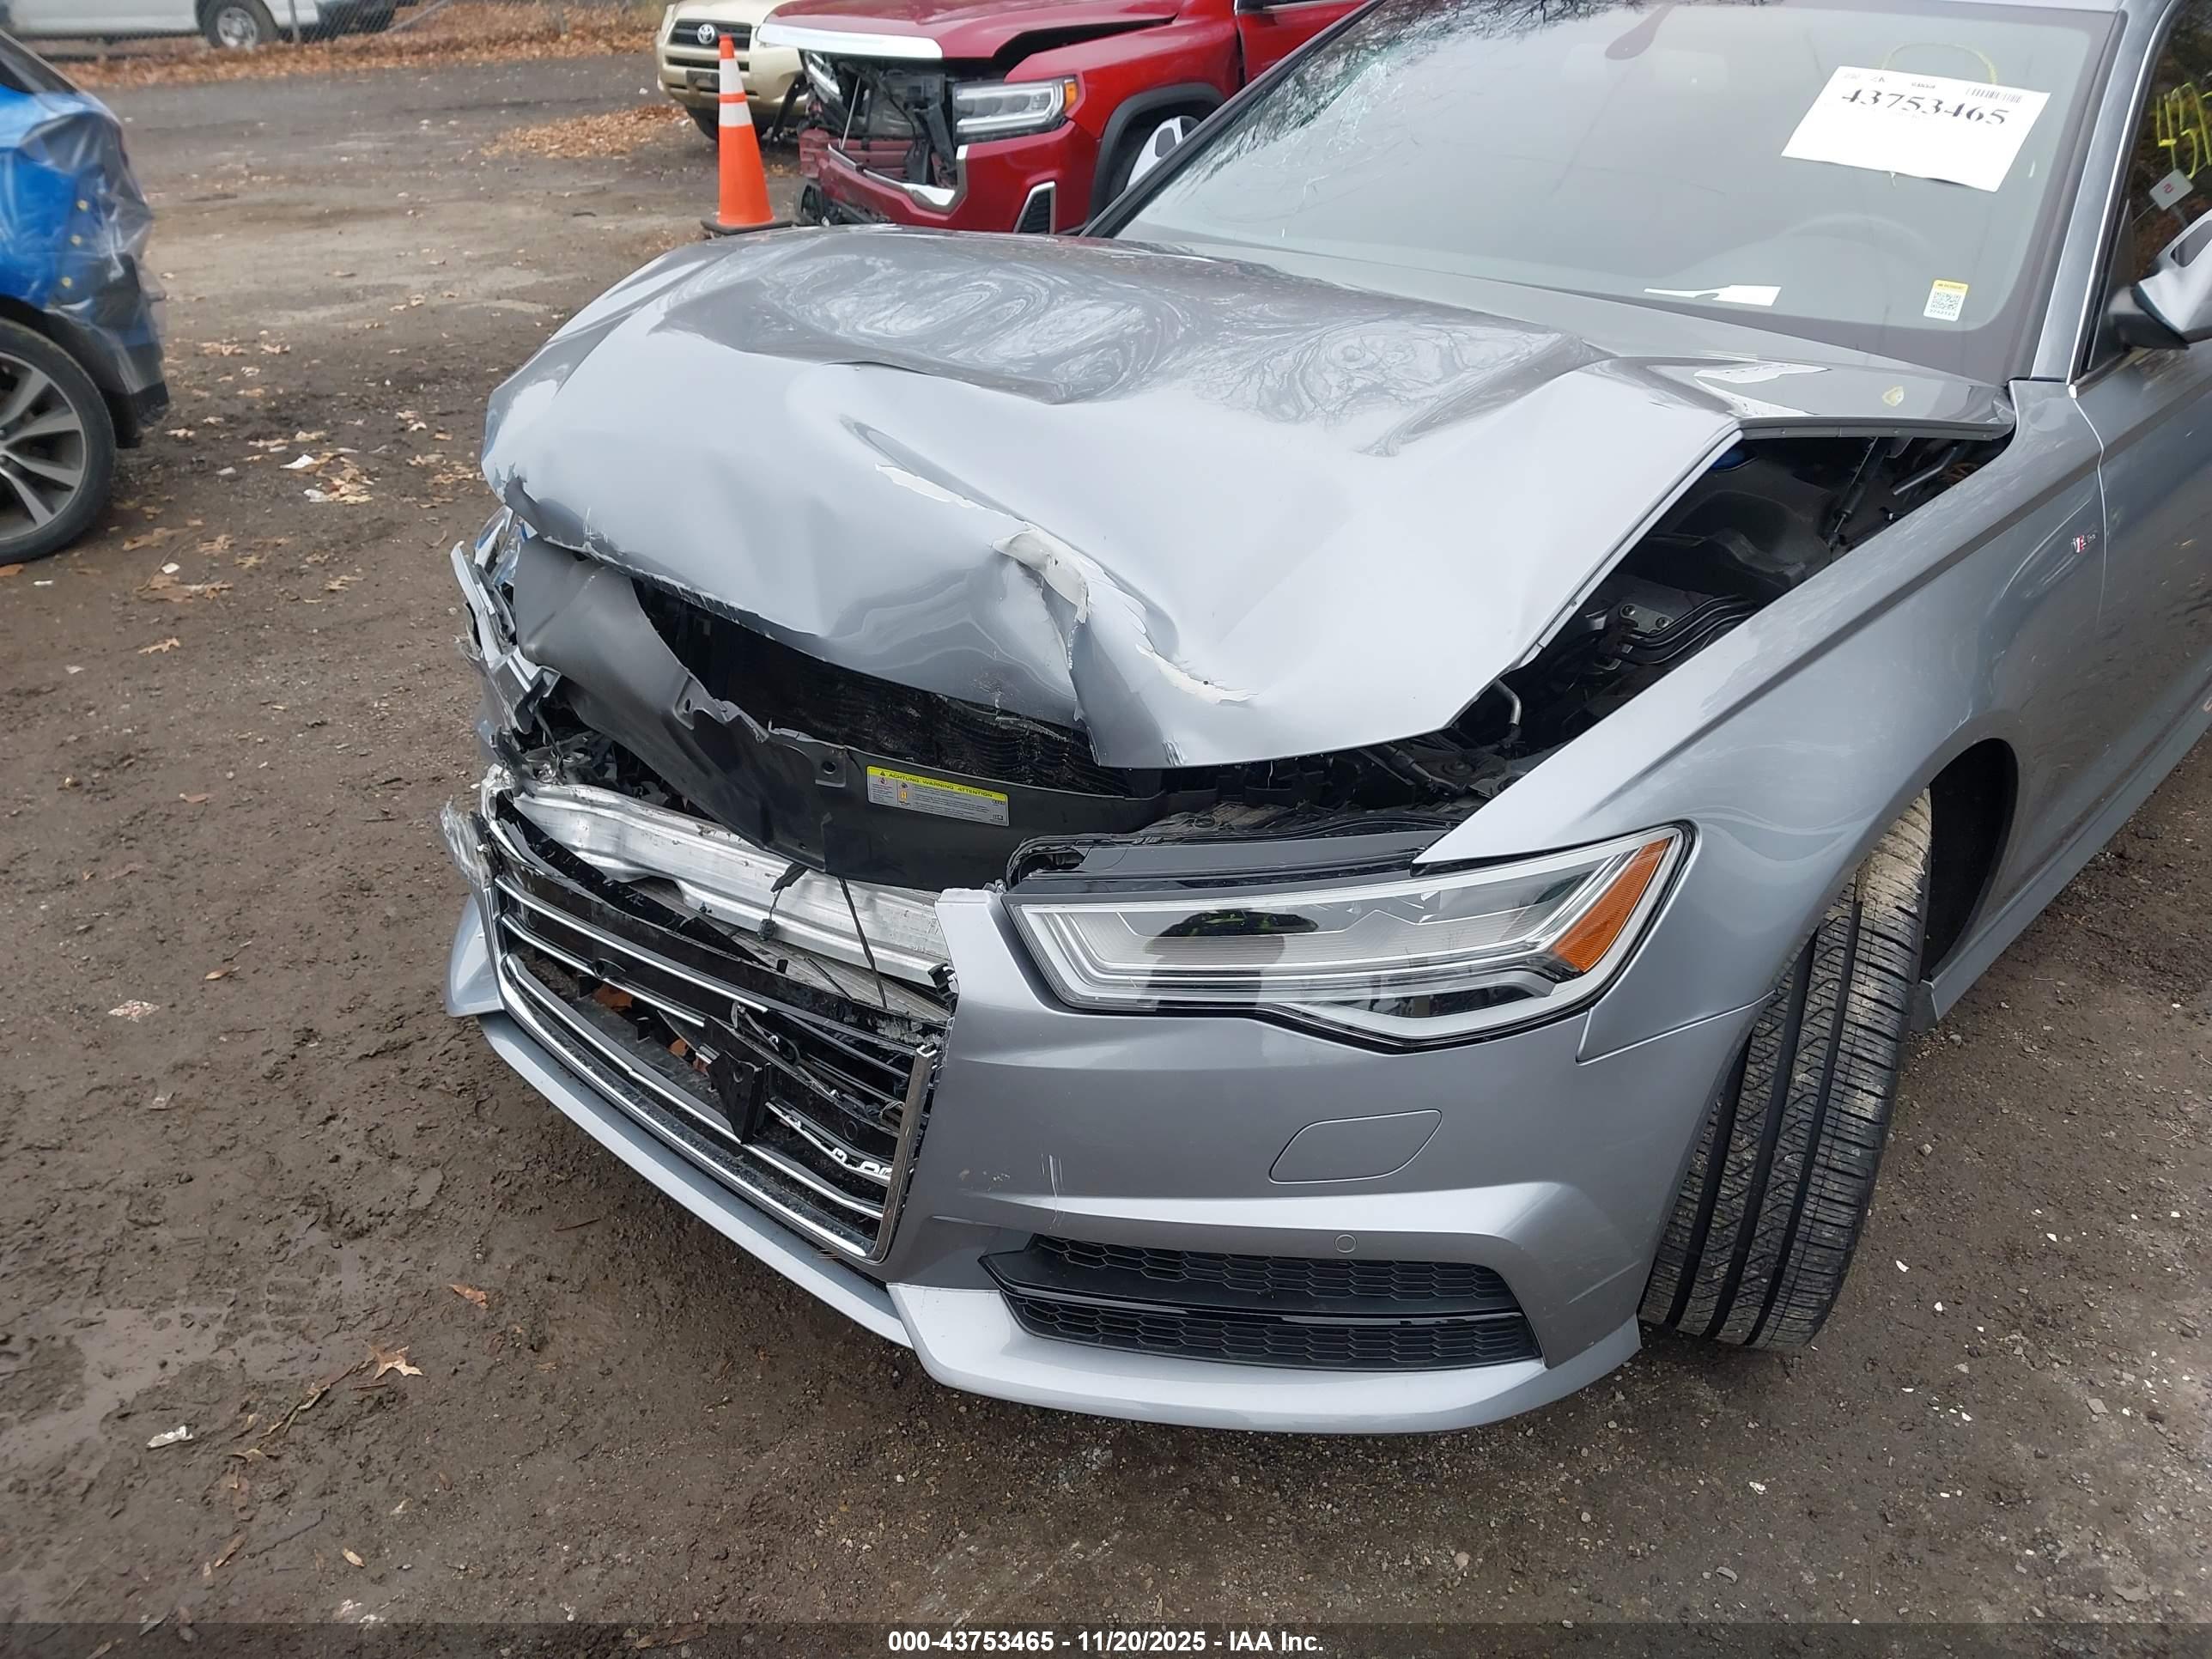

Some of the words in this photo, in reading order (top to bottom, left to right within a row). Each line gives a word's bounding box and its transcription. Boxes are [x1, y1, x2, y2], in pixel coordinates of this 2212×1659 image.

[1841, 88, 2010, 125] 43753465
[888, 773, 920, 783] ACHTUNG
[922, 780, 954, 790] WARNING
[957, 787, 994, 798] ATTENTION
